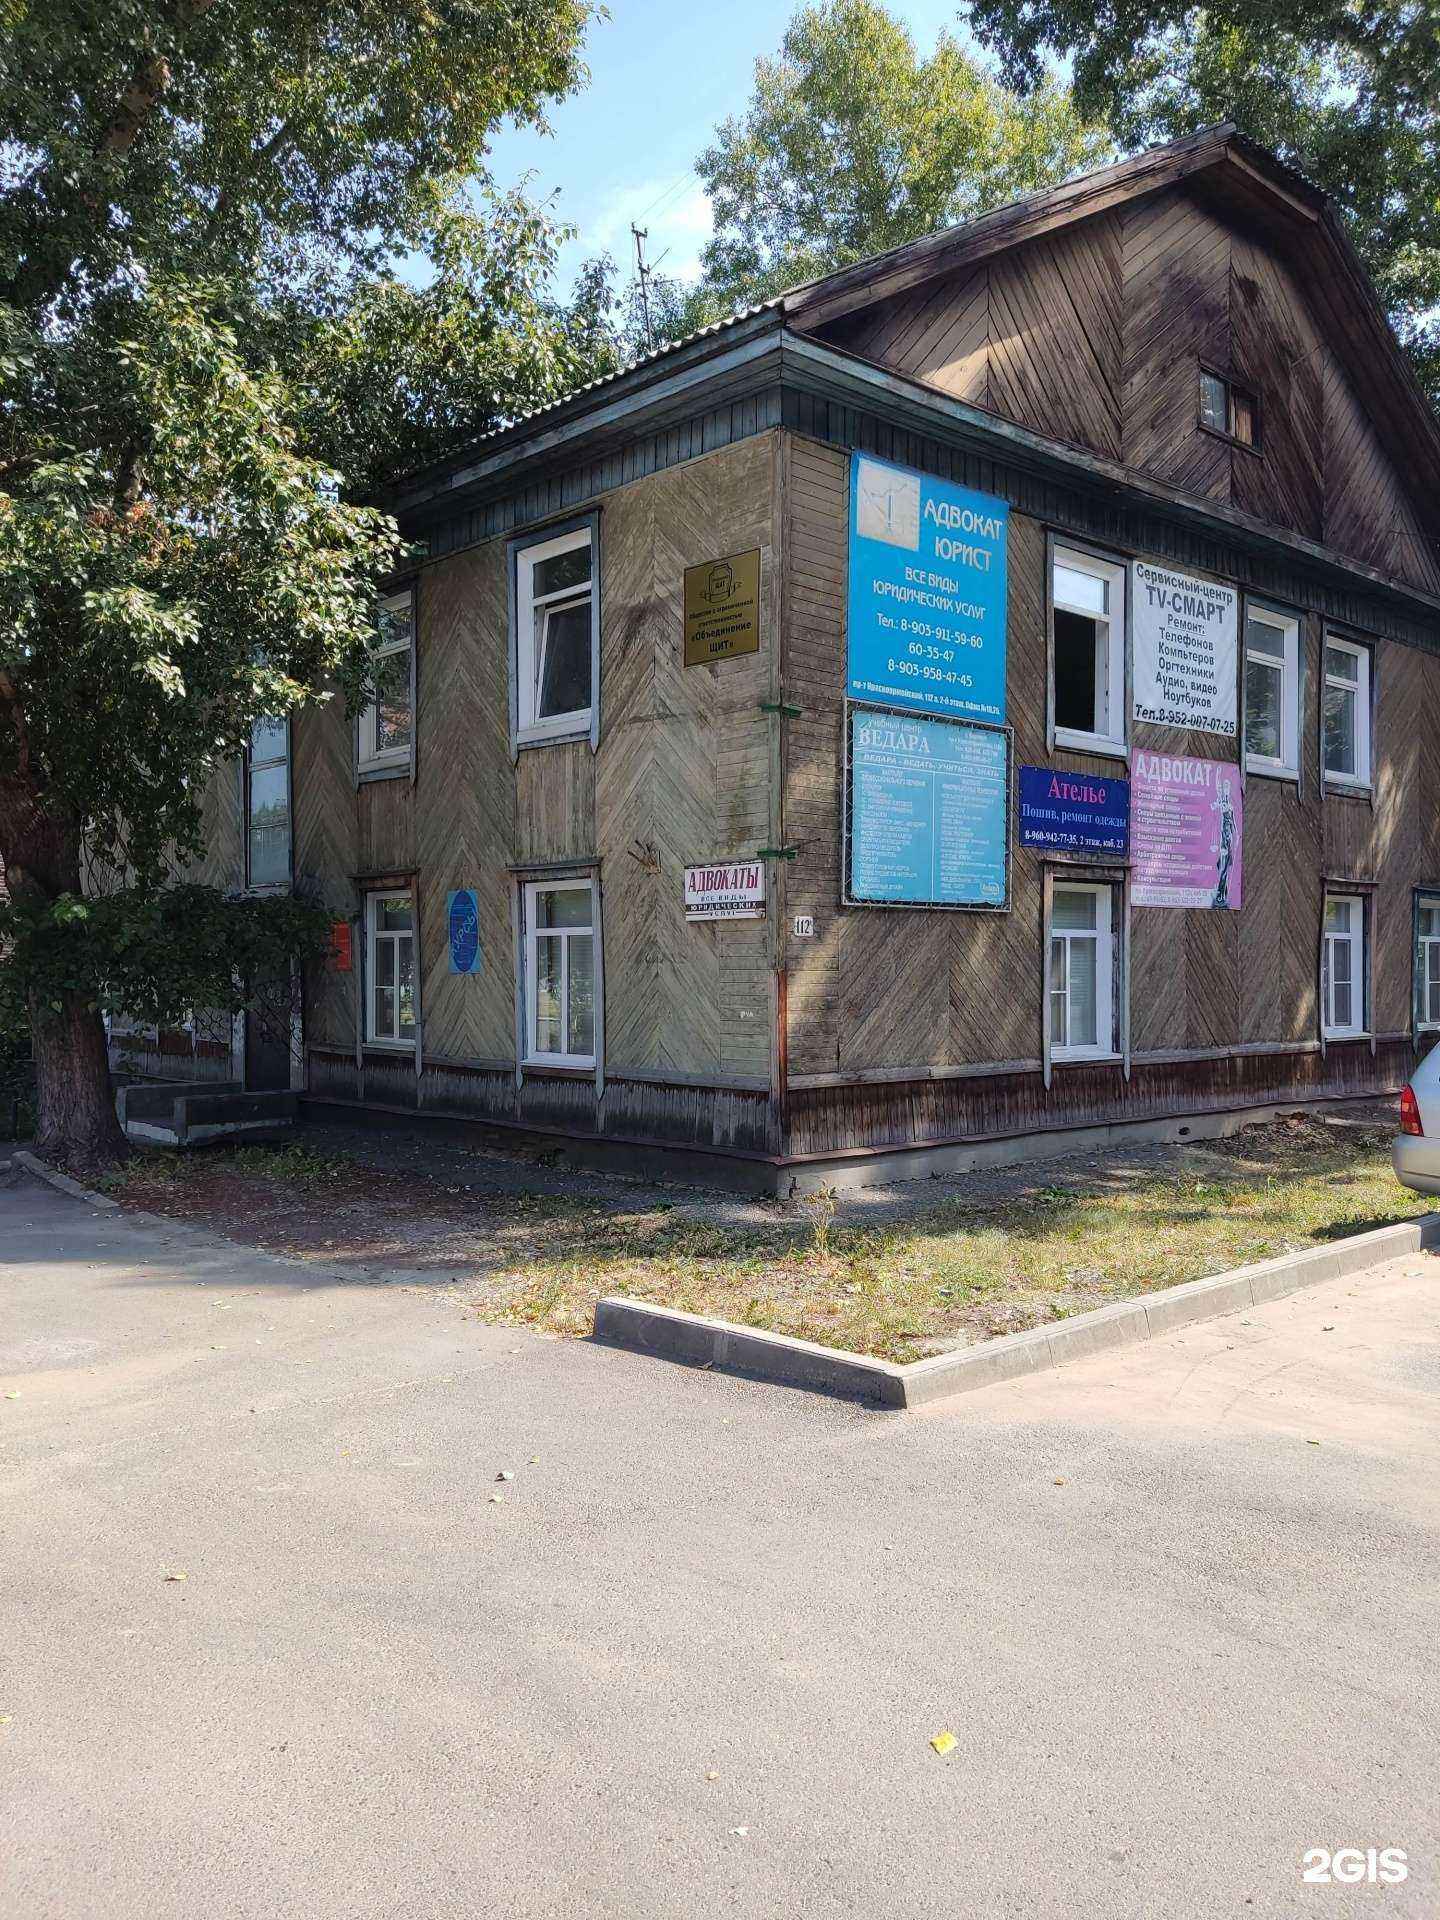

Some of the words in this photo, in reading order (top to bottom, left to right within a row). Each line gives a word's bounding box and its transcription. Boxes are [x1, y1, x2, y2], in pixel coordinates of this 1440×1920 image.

[924, 499, 1003, 540] АДВОКАТ
[935, 537, 992, 572] ЮРИСТ
[905, 566, 926, 582] ВСЕ
[928, 571, 959, 593] ВИДЫ
[1136, 563, 1233, 604] Сервисный-центр
[873, 579, 954, 611] ЮРИДИЧЕСКИХ
[955, 602, 986, 619] УСЛУГ
[1145, 584, 1226, 624] TV-СМАРТ
[877, 613, 899, 629] Тел.:
[900, 618, 983, 648] 8-903-911-59-60
[1167, 614, 1206, 634] Ремонт:
[909, 642, 954, 662] 60-35-47
[1158, 626, 1214, 651] Телефонов
[1158, 641, 1214, 666] Компьтеров
[888, 659, 973, 687] 8-903-958-47-45
[1158, 656, 1215, 680] Оргтехники
[1155, 671, 1188, 691] Аудио,
[1190, 681, 1218, 695] видео
[1163, 688, 1212, 708] Ноутбуков
[859, 728, 930, 753] ВЕДАРА
[1135, 754, 1213, 787] АДВОКАТ
[1048, 775, 1106, 804] Ателье
[1022, 803, 1060, 821] Пошив,
[1061, 811, 1093, 824] ремонт
[1095, 815, 1127, 828] одежды
[688, 867, 759, 895] АДВОКАТЫ
[690, 902, 757, 911] ЮРИДИЧЕСКИХ
